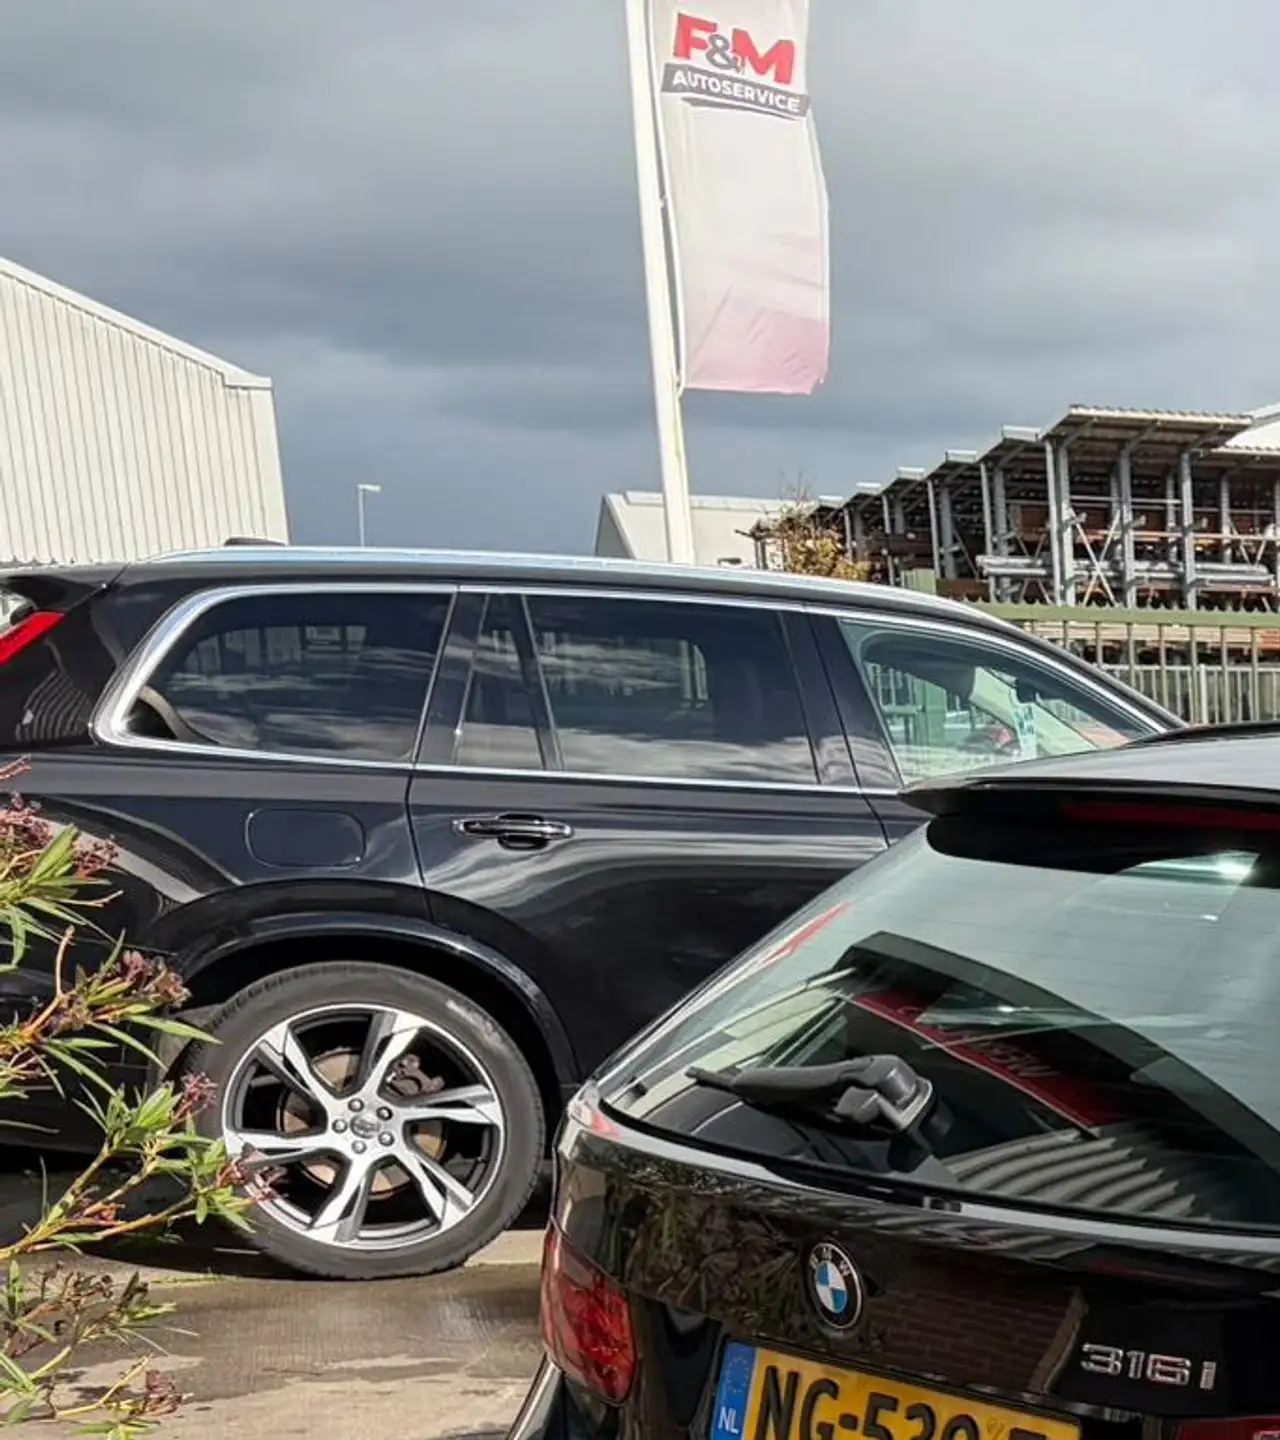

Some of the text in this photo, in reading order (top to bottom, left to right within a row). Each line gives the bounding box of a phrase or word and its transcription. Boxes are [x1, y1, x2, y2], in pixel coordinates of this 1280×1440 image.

[673, 13, 795, 85] F&M
[672, 69, 801, 113] AUTOSERVICE
[1080, 1343, 1217, 1390] 316i
[718, 1405, 739, 1434] NL
